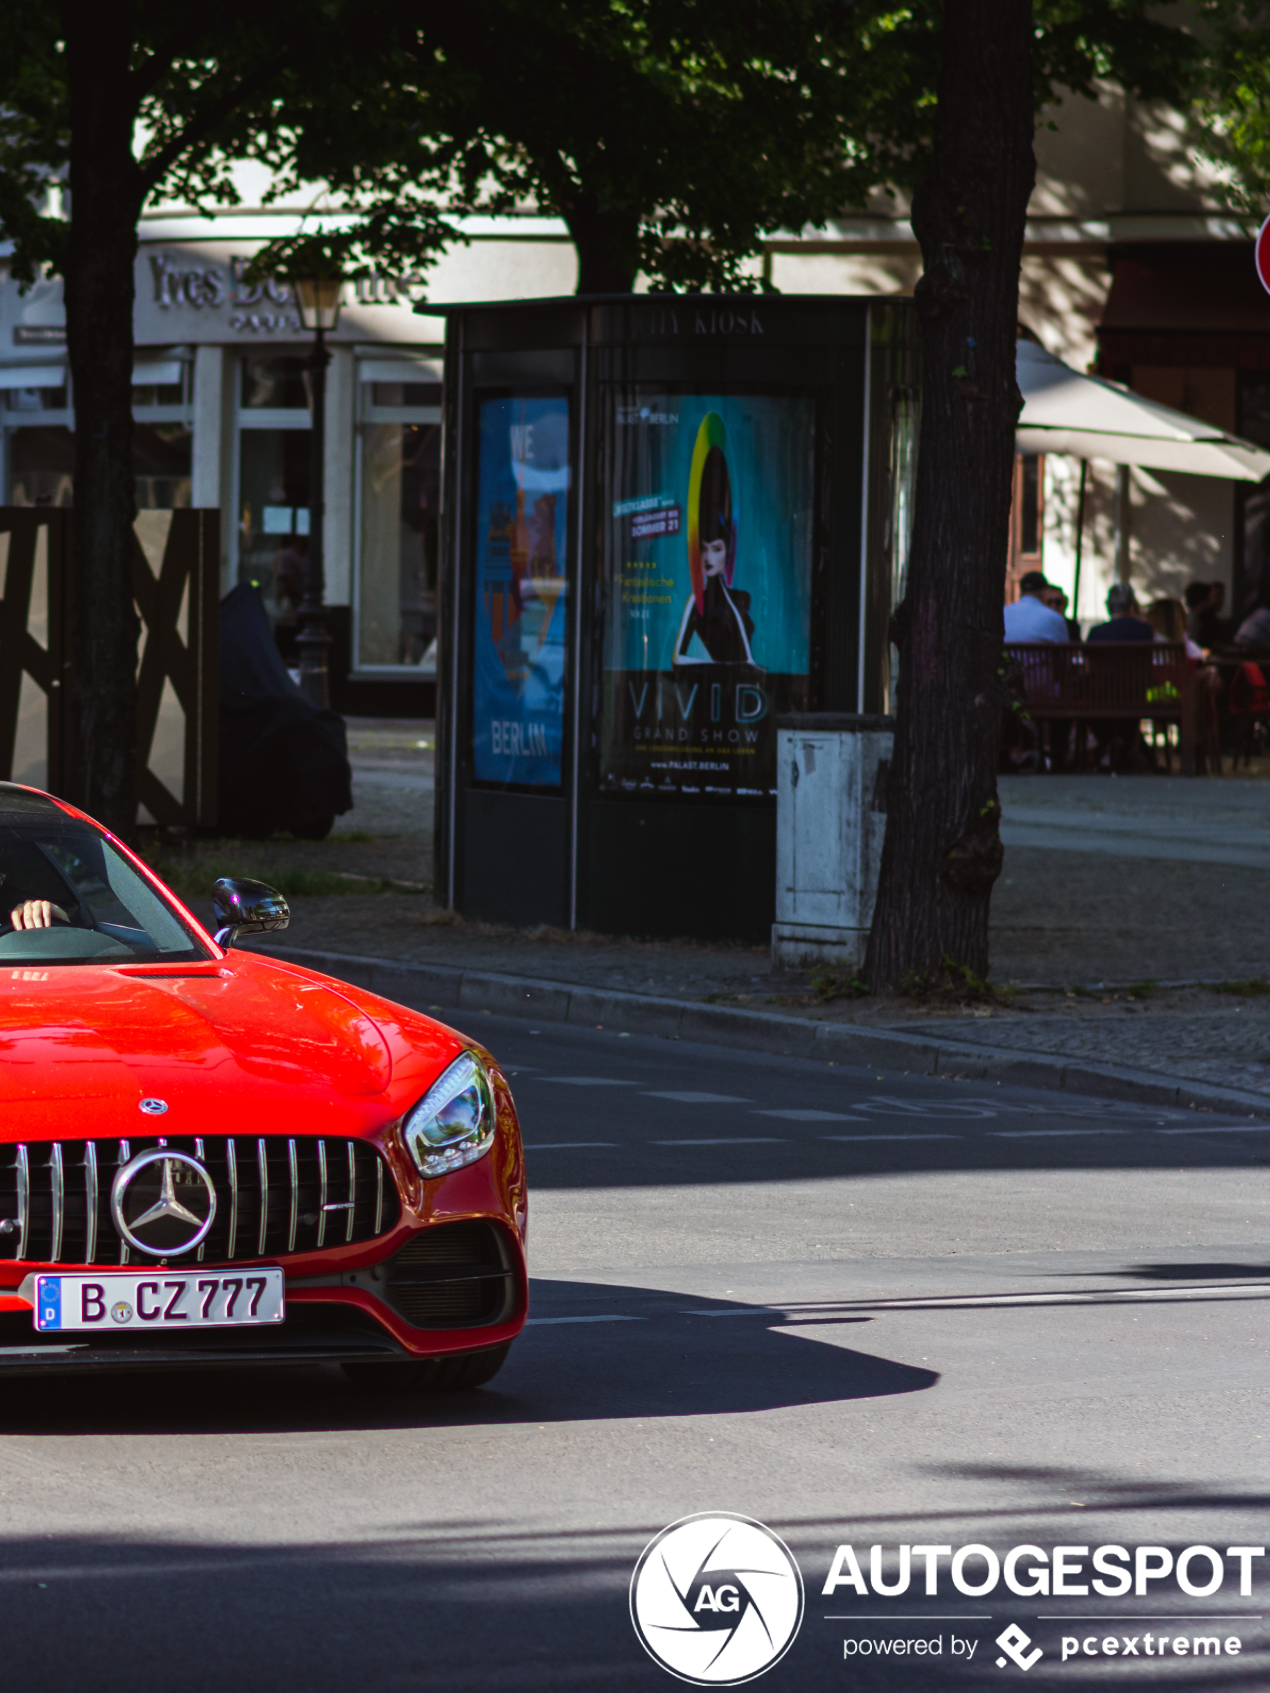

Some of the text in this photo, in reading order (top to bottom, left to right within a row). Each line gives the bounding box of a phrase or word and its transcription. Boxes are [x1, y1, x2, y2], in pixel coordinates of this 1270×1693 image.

[148, 255, 225, 309] Yves
[695, 309, 765, 335] KIOSK
[510, 424, 534, 459] WE
[631, 519, 679, 537] SOMMER 21
[628, 681, 769, 723] VIVID
[491, 720, 547, 756] BERLIN
[634, 727, 759, 743] GRAND SHOW
[650, 760, 729, 771] www.PALAST.BERLIN
[45, 1308, 56, 1320] D
[81, 1277, 267, 1322] B CZ 777
